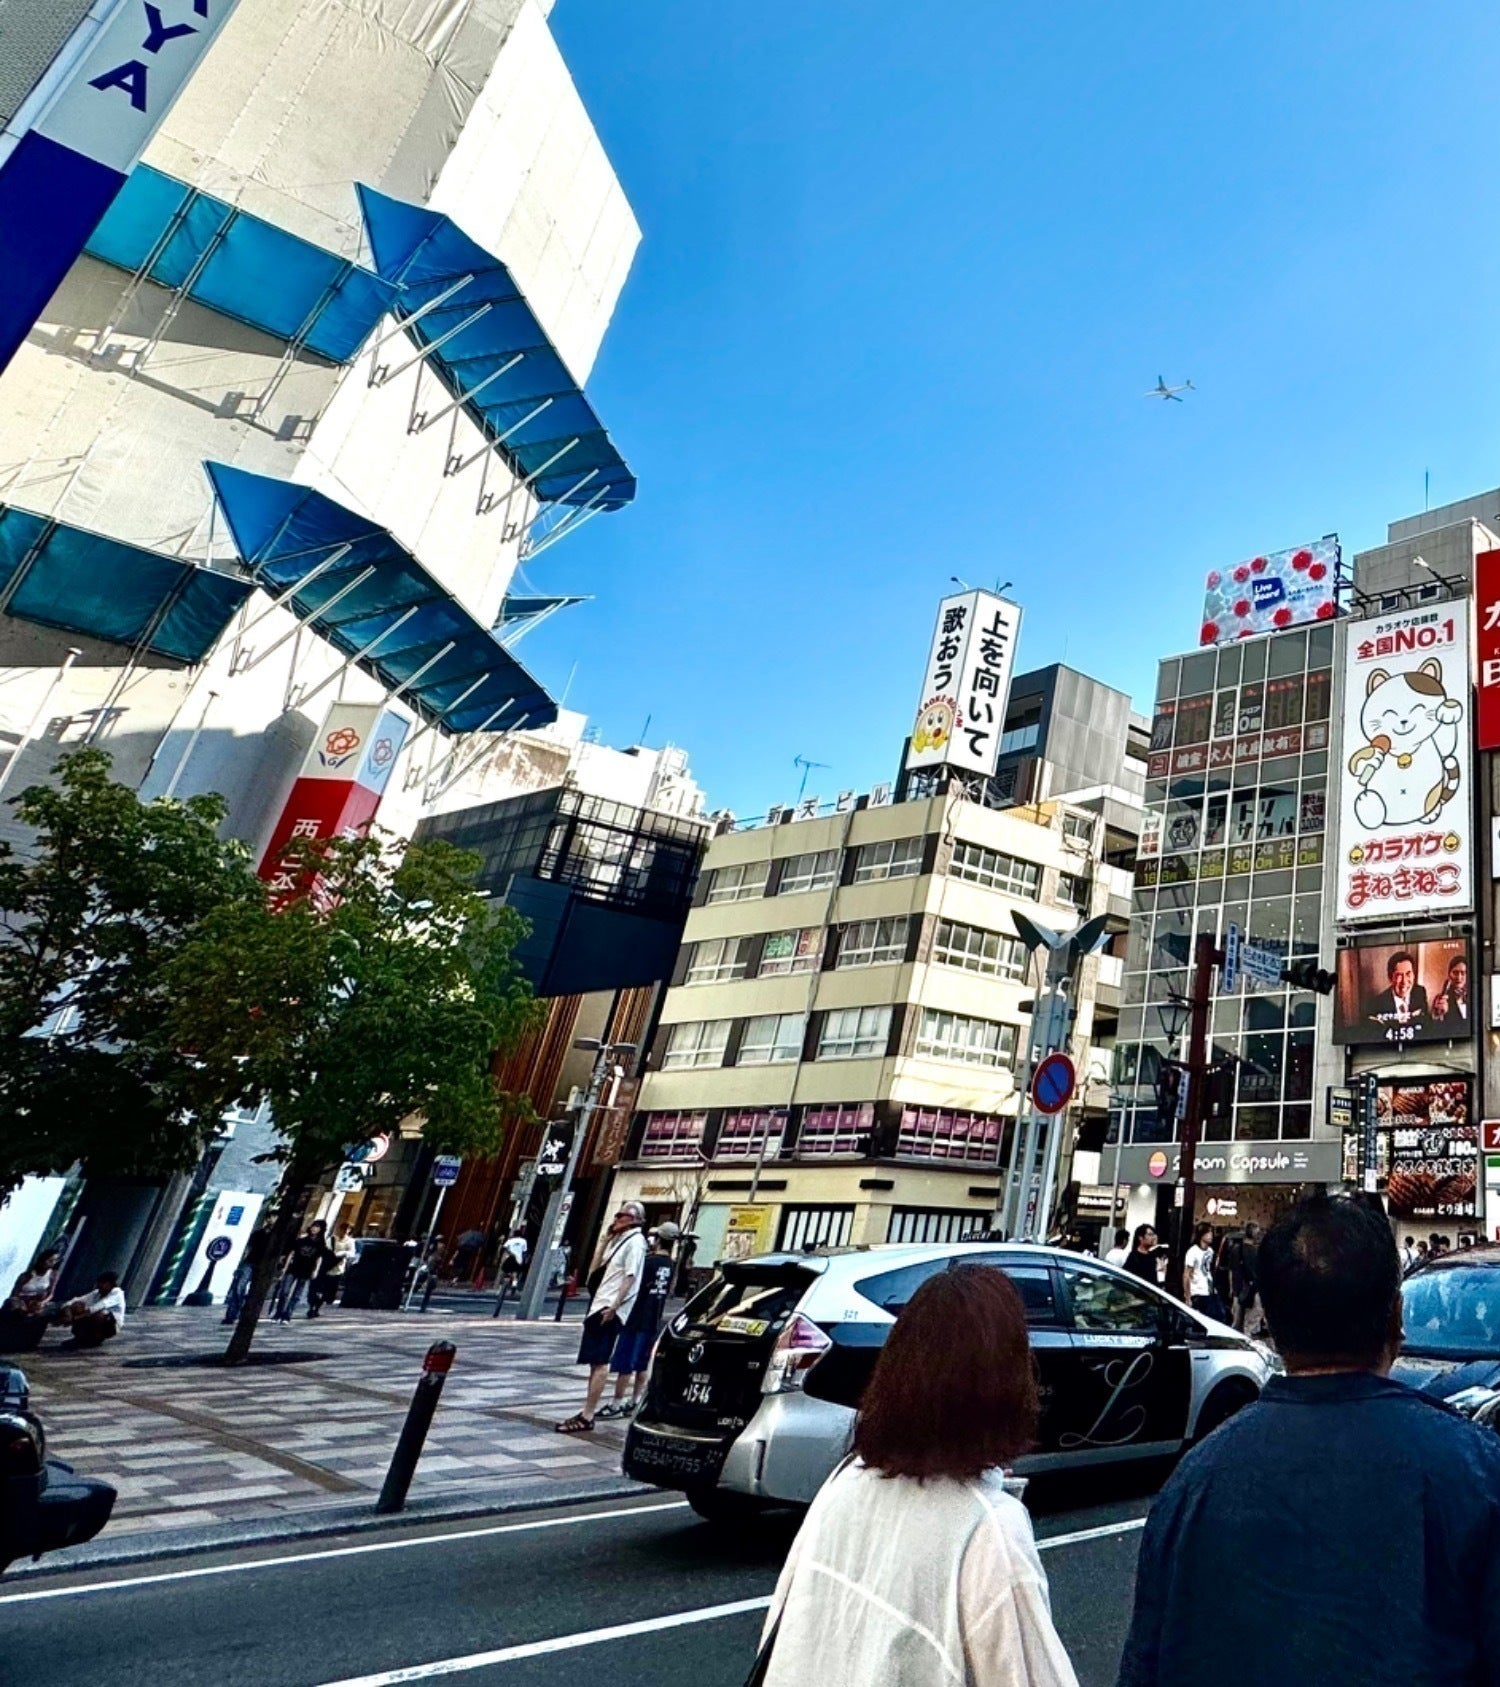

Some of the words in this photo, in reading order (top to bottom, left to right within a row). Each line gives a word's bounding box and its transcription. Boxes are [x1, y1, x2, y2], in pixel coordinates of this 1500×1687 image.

[933, 605, 968, 692] 歌おう
[1356, 618, 1456, 661] 全国No.1
[963, 610, 1010, 758] 上を向いて
[1363, 832, 1444, 862] カラオケ
[1347, 864, 1461, 910] まねきねこ
[1385, 1026, 1415, 1041] 4:58
[1230, 1152, 1290, 1174] Capsule
